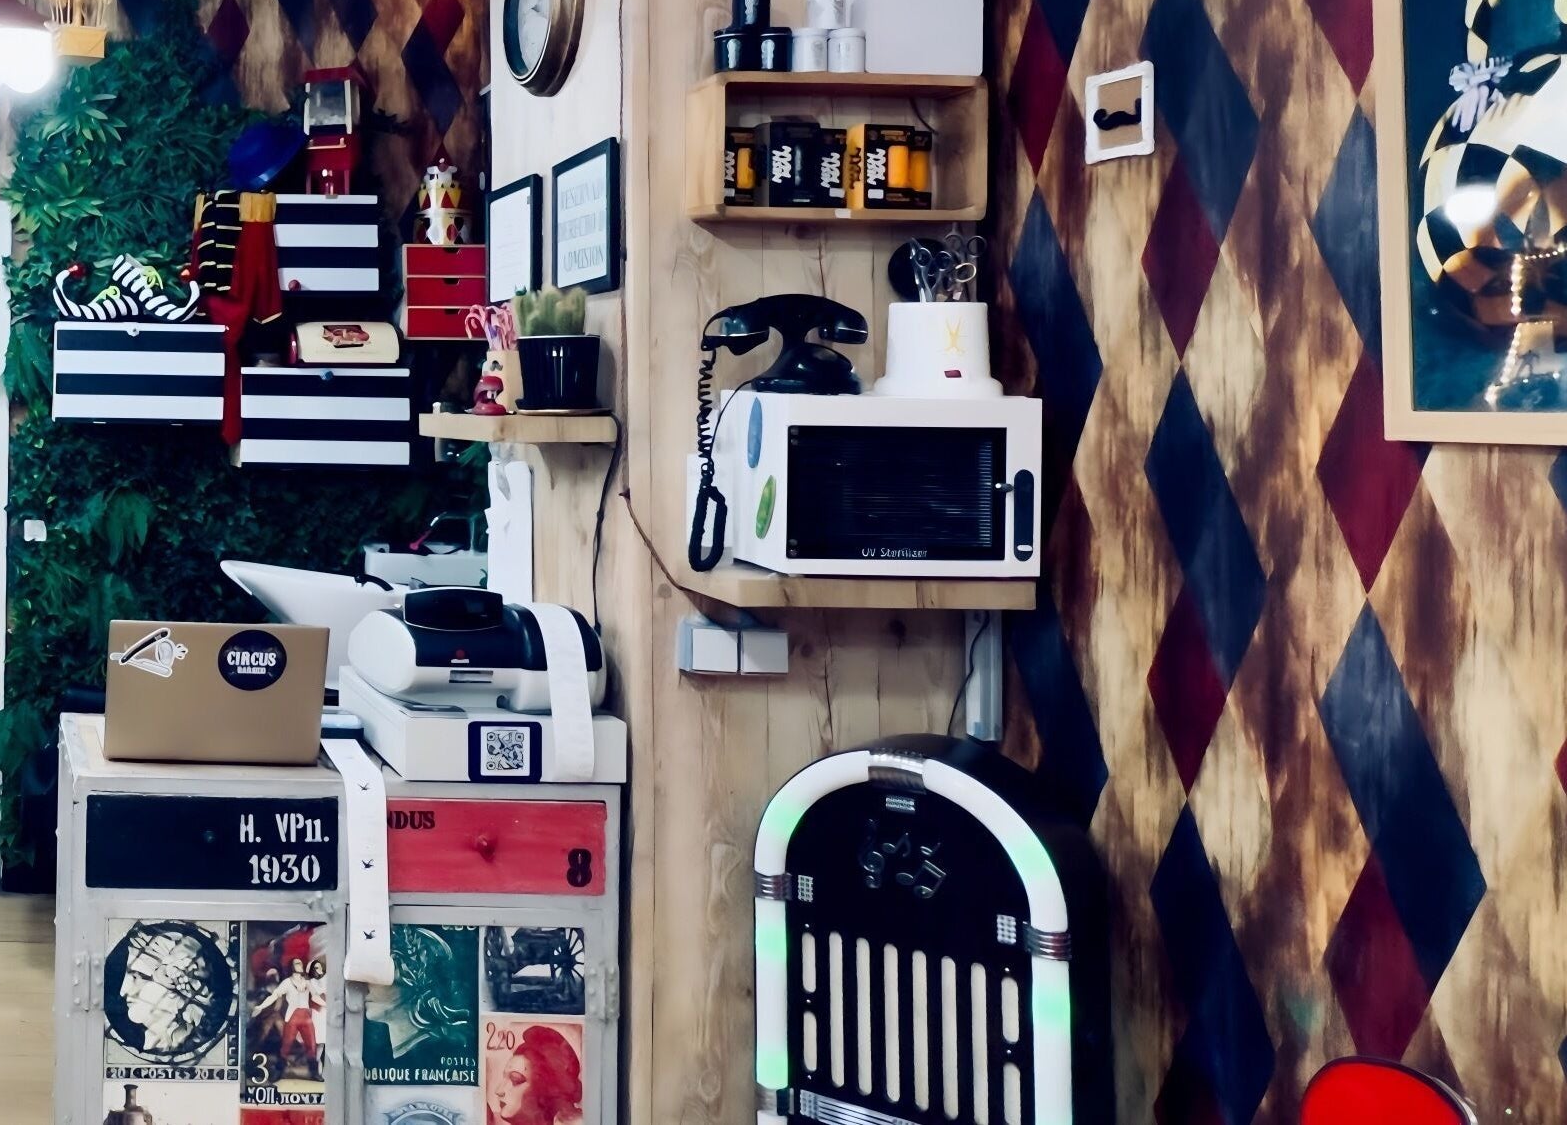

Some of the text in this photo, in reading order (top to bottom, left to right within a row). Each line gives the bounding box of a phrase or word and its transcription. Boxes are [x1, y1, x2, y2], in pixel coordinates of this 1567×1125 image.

[861, 547, 876, 557] UV
[226, 650, 277, 666] CIRCUS
[239, 813, 262, 843] H.
[248, 853, 321, 885] 1930
[566, 848, 593, 888] 8
[251, 1053, 270, 1085] 3
[440, 1056, 476, 1067] POSTES
